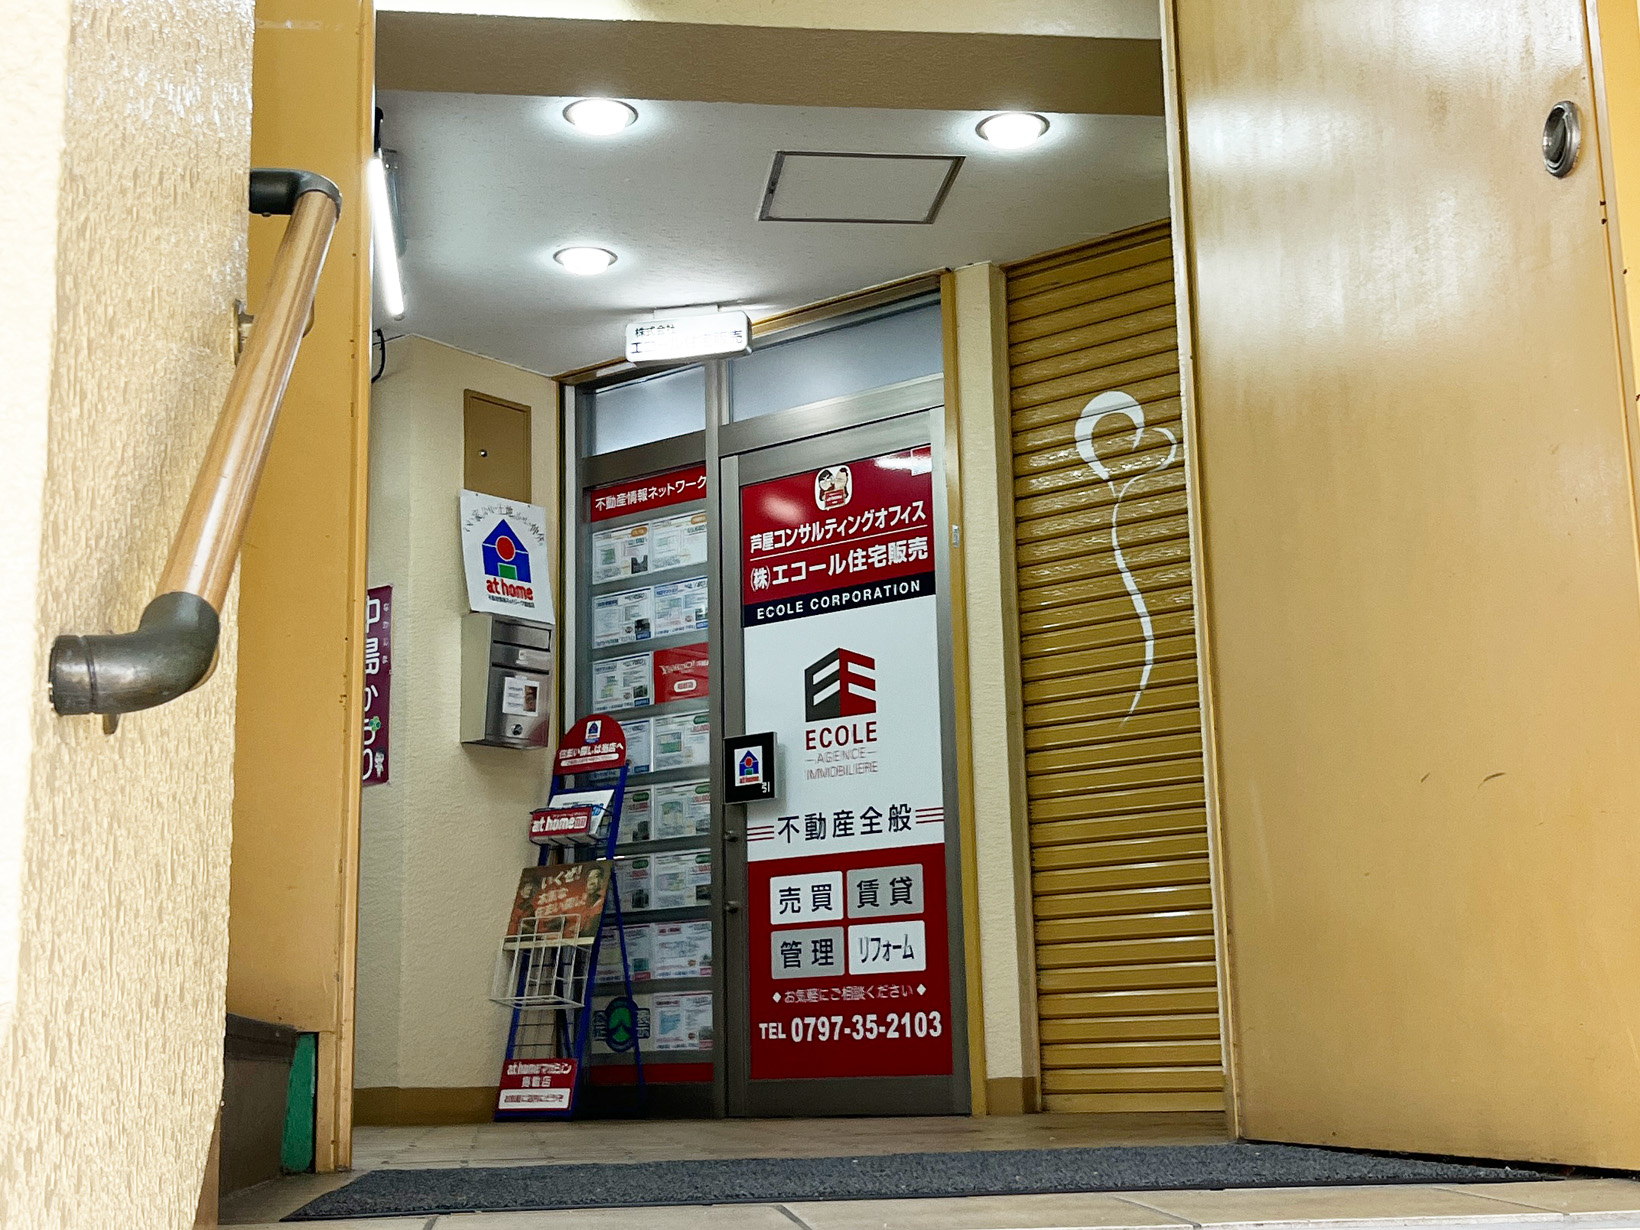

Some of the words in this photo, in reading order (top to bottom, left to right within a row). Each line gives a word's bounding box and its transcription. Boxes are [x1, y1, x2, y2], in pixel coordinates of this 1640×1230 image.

[594, 475, 707, 512] 不動産情報ネットワーク
[750, 500, 927, 554] 芦屋コンサルティングオフィス
[486, 577, 500, 595] at
[500, 579, 534, 600] home
[757, 601, 804, 620] ECOLE
[810, 580, 921, 610] CORPORATION
[805, 721, 878, 750] ECOLE
[817, 747, 866, 764] AGENCE
[806, 761, 879, 781] IMMOBILIERE
[761, 782, 770, 793] 引
[532, 817, 545, 832] at
[545, 815, 575, 831] home
[777, 803, 912, 843] 不動産全般
[778, 884, 833, 915] 売買
[856, 876, 913, 909] 賃貸
[780, 938, 834, 969] 管理
[858, 933, 915, 963] リフォーム
[784, 984, 913, 1004] お気軽にご相談ください
[759, 1022, 786, 1040] TEL
[791, 1011, 942, 1042] 0797-35-2103
